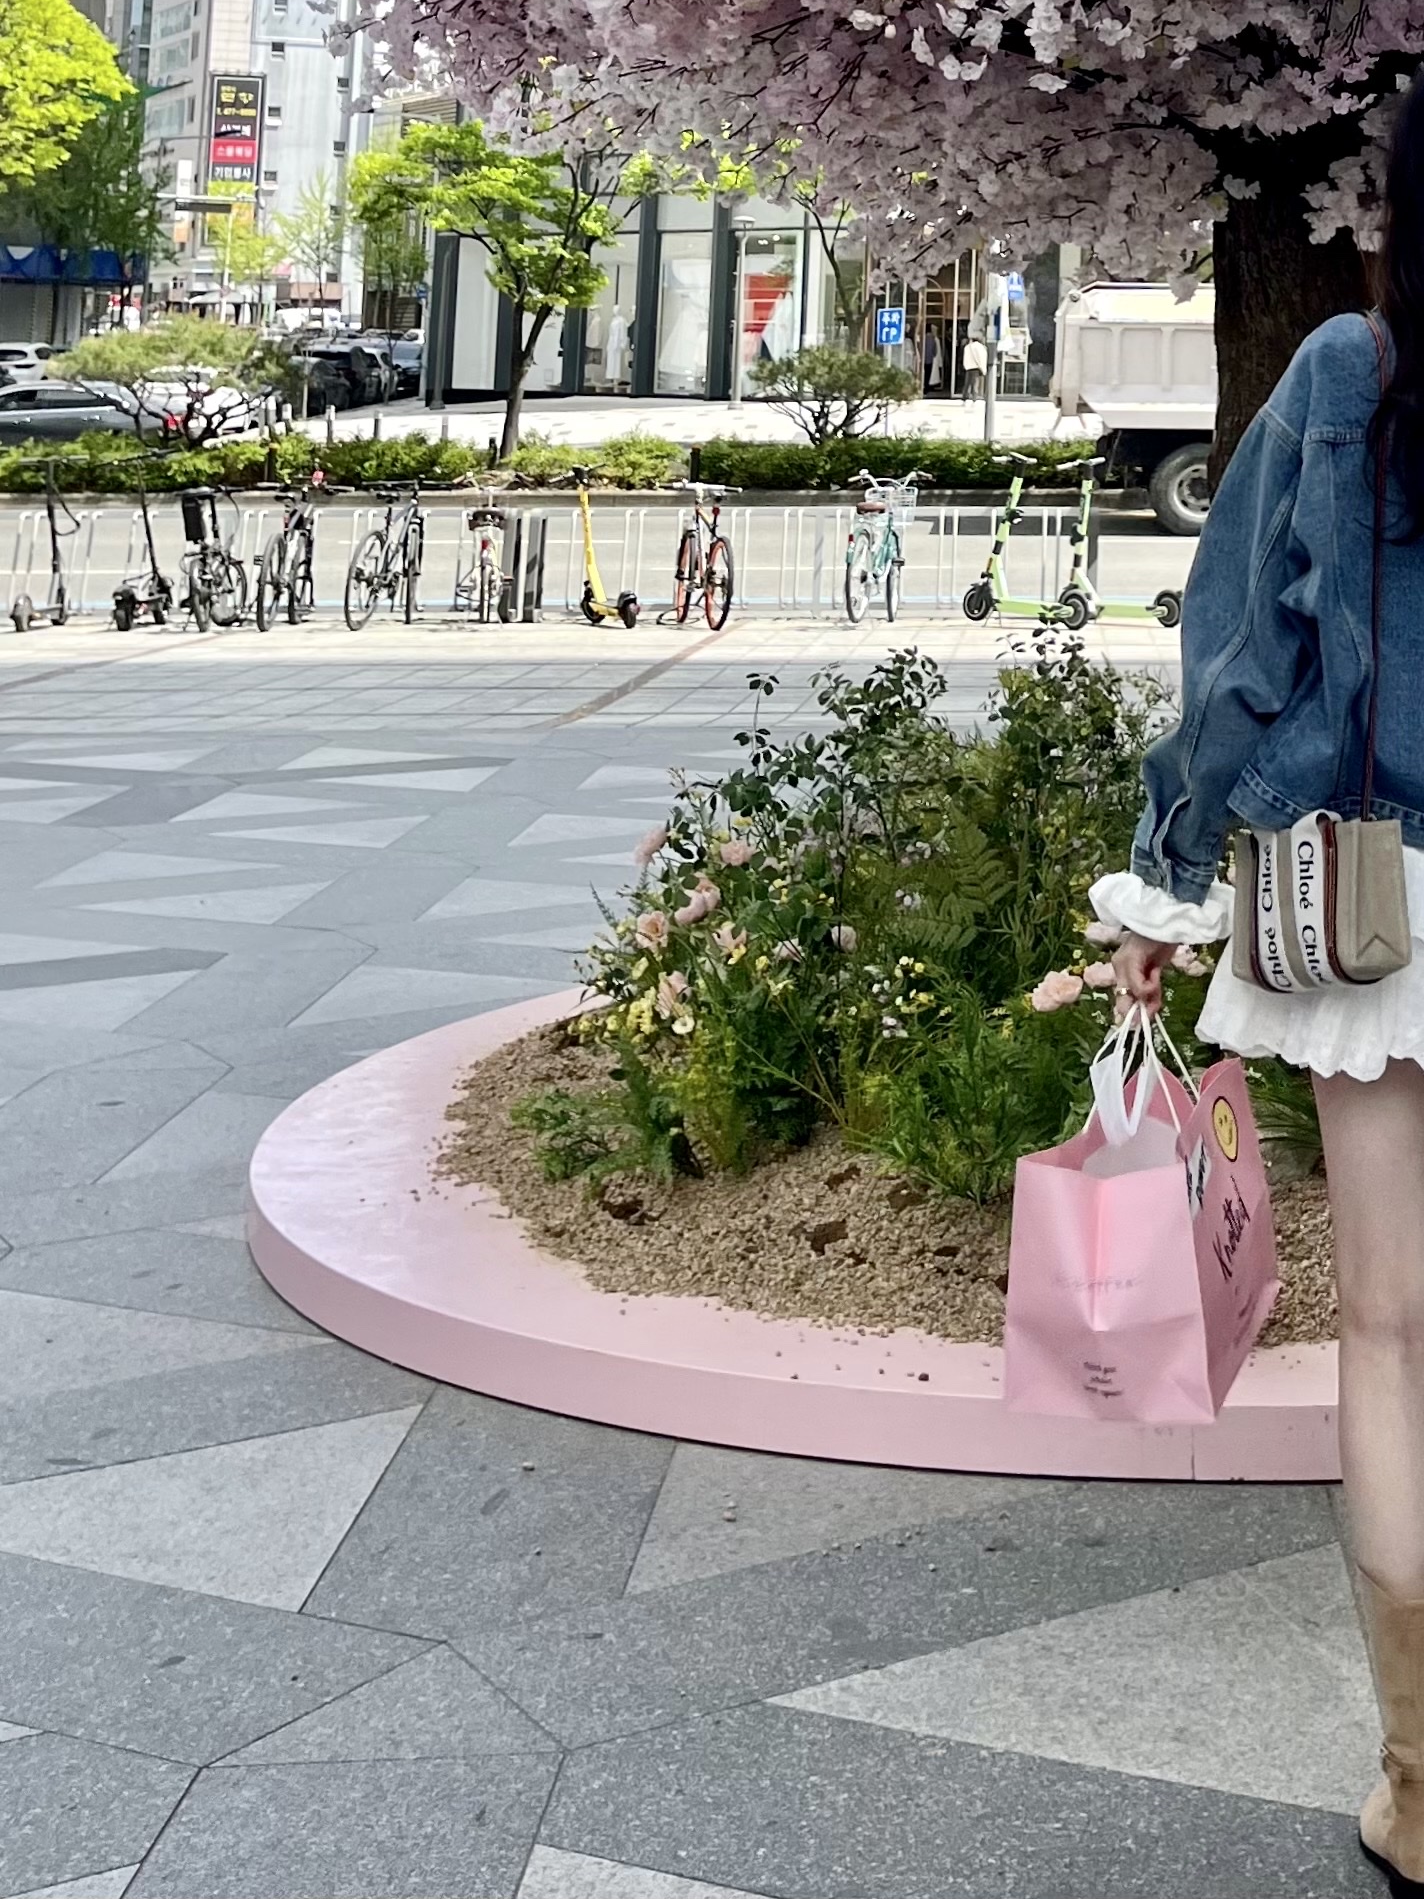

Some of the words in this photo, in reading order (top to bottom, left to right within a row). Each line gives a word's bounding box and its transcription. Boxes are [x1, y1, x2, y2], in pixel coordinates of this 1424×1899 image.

[1261, 843, 1274, 913] Chloé
[1297, 840, 1315, 910] Chloé
[1264, 926, 1293, 989] Chloé
